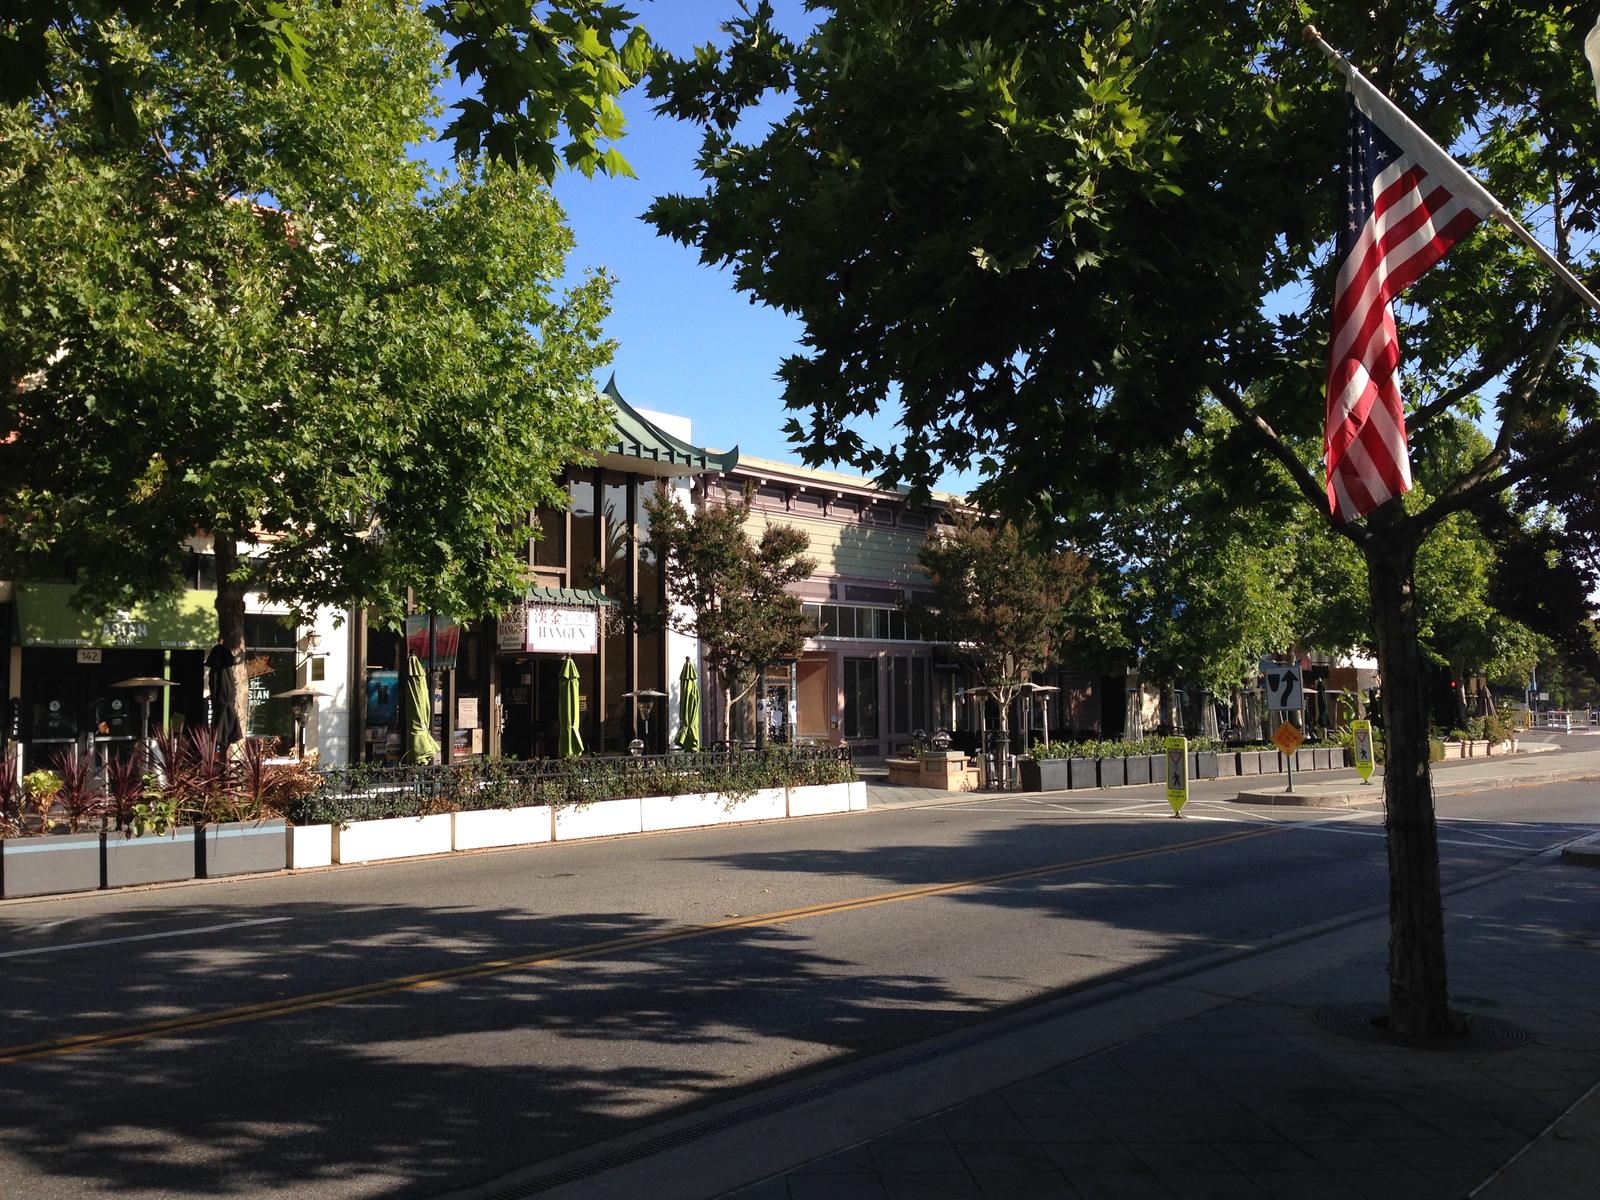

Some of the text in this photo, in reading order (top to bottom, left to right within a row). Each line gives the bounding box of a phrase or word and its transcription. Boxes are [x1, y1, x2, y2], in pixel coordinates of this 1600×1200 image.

[102, 623, 148, 637] ASIAN
[538, 626, 586, 639] HANGEN
[81, 651, 98, 661] 142
[248, 690, 270, 700] SIAN
